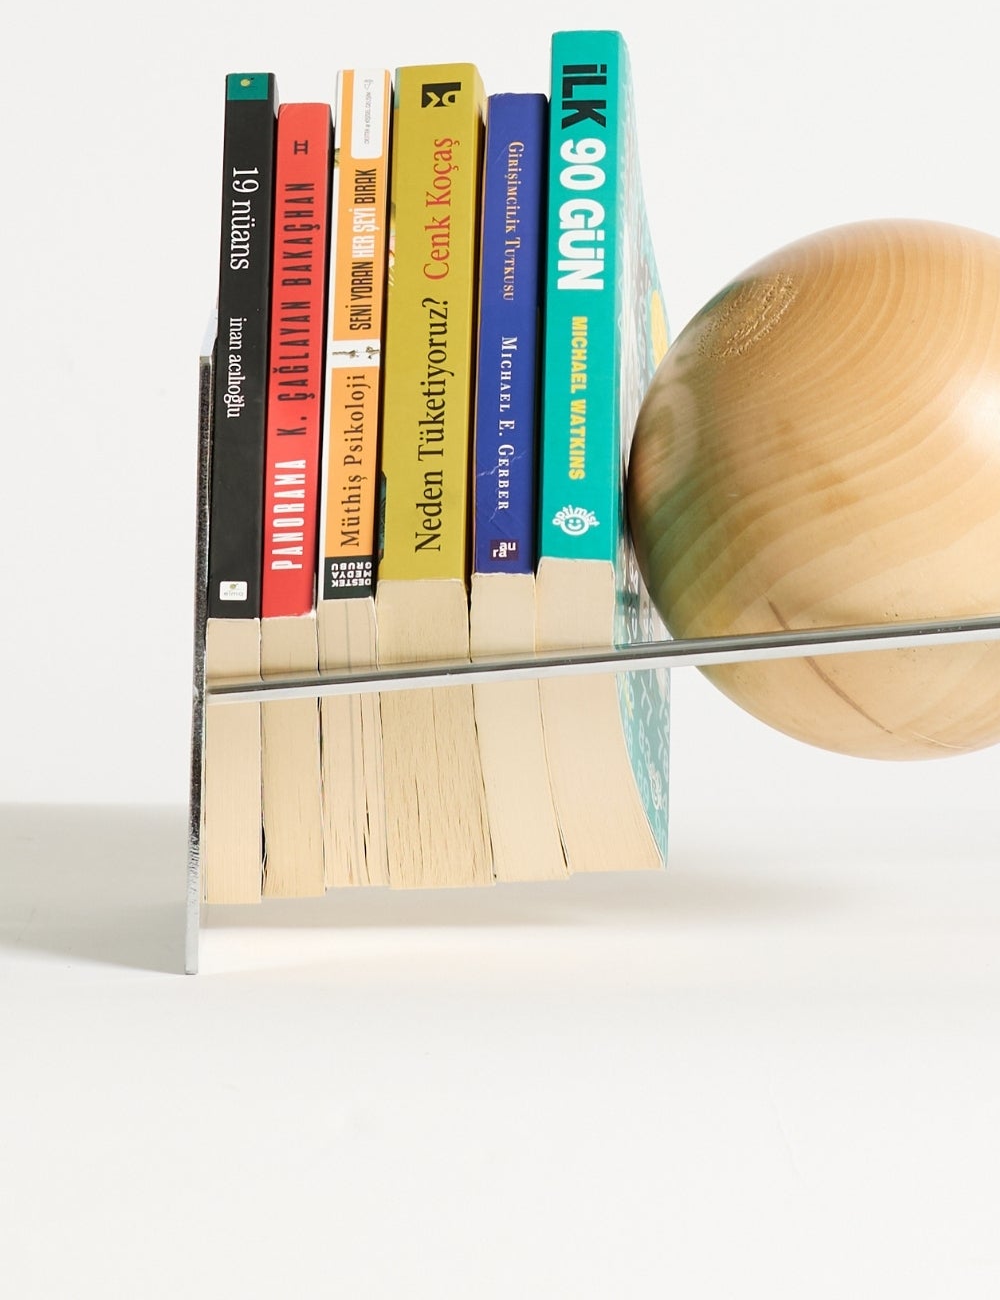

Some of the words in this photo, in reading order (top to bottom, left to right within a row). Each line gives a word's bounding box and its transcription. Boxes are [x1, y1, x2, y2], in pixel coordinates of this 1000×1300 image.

[231, 167, 260, 194] 19
[354, 168, 377, 205] BIRAK
[425, 137, 460, 208] Koçaş
[559, 137, 607, 191] 90
[229, 199, 256, 271] nüans
[281, 182, 321, 287] BAKAÇHAN
[348, 206, 380, 234] ŞEYİ
[351, 234, 375, 259] HER
[557, 198, 606, 291] GÜN
[423, 214, 451, 281] Cenk
[350, 261, 374, 302] YORAN
[229, 317, 248, 352] inan
[345, 305, 373, 331] SENİ
[272, 300, 316, 402] ÇAĞLAYAN
[570, 316, 588, 394] MICHAEL
[417, 297, 455, 462] Tüketiyoruz?
[343, 374, 372, 467] Psikoloji
[498, 419, 515, 437] E.
[568, 399, 587, 480] WATKINS
[271, 459, 307, 571] PANORAMA
[340, 474, 368, 548] Müthiş
[414, 470, 444, 553] Neden
[552, 504, 600, 527] optimist
[331, 561, 372, 571] GRUBU
[331, 570, 372, 580] MEDYA
[331, 579, 371, 588] DESTEK
[223, 590, 244, 598] elma
